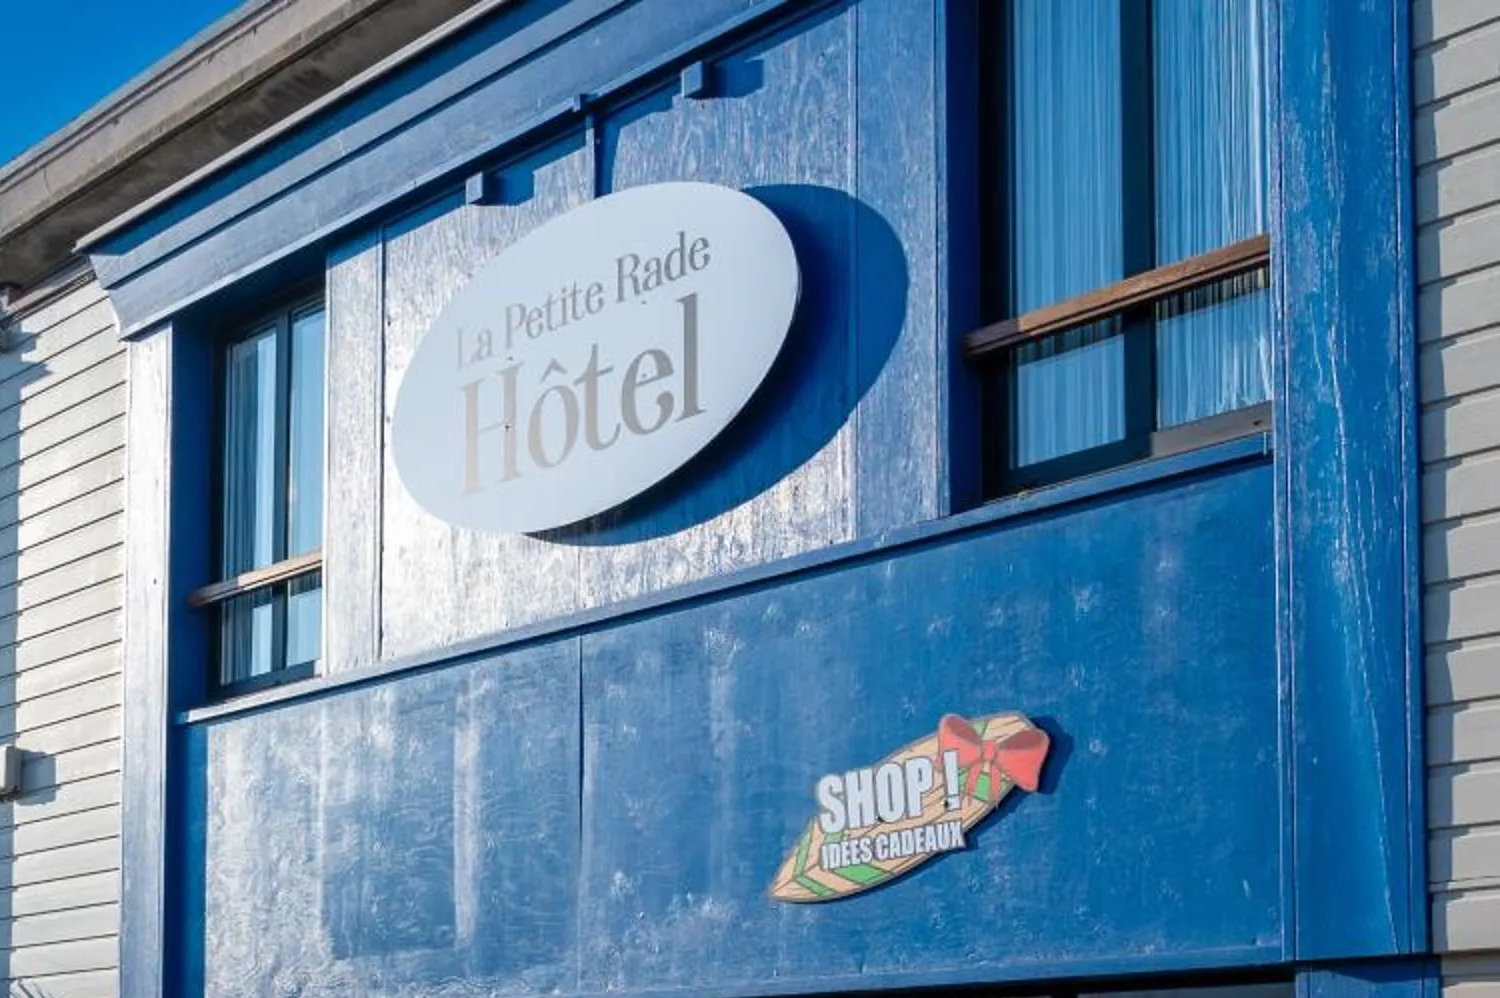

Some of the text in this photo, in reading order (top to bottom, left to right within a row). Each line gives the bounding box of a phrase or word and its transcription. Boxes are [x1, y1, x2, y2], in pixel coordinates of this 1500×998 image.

[456, 231, 710, 371] La Petite Rade
[460, 291, 706, 498] Hôtel
[817, 757, 934, 833] SHOP
[875, 820, 966, 861] CADEAUX
